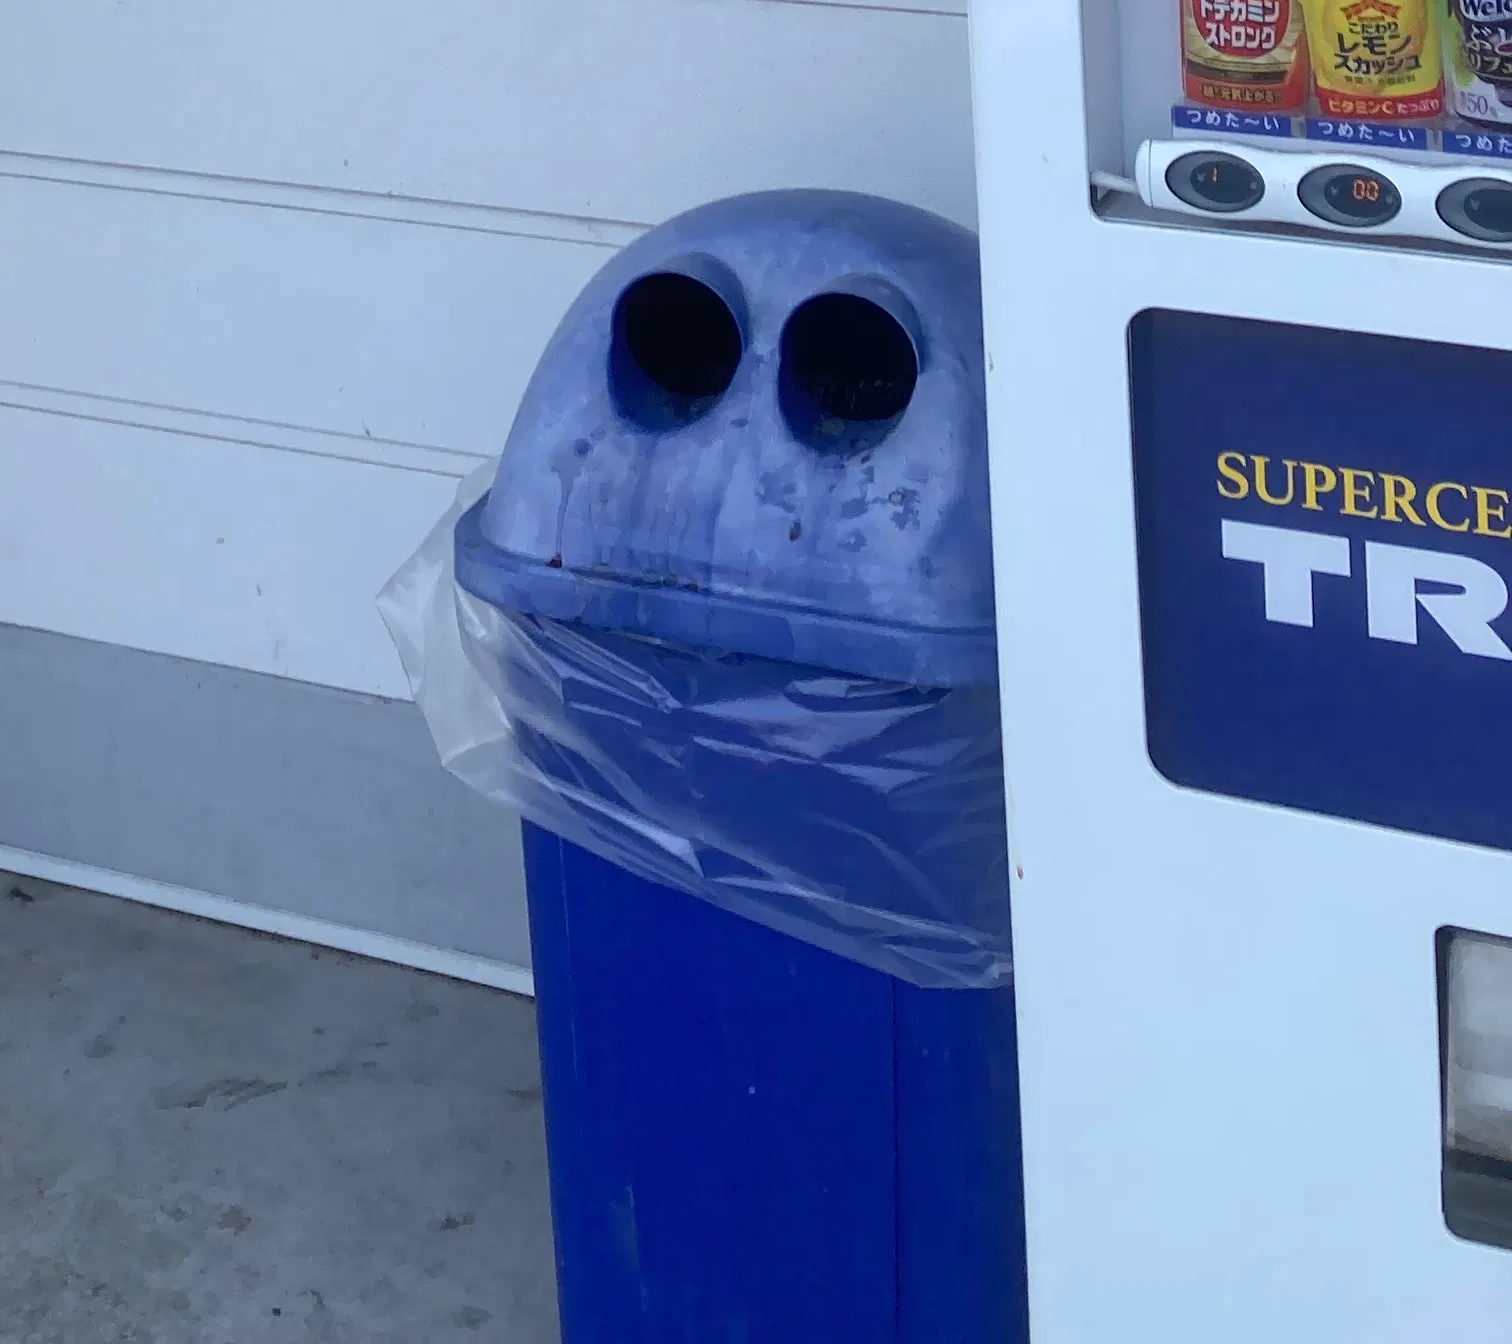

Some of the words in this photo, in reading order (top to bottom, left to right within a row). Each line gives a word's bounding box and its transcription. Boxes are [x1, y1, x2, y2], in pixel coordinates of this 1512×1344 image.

[1206, 21, 1276, 50] ストロング
[1336, 31, 1412, 56] レモン
[1221, 518, 1512, 661] TR
